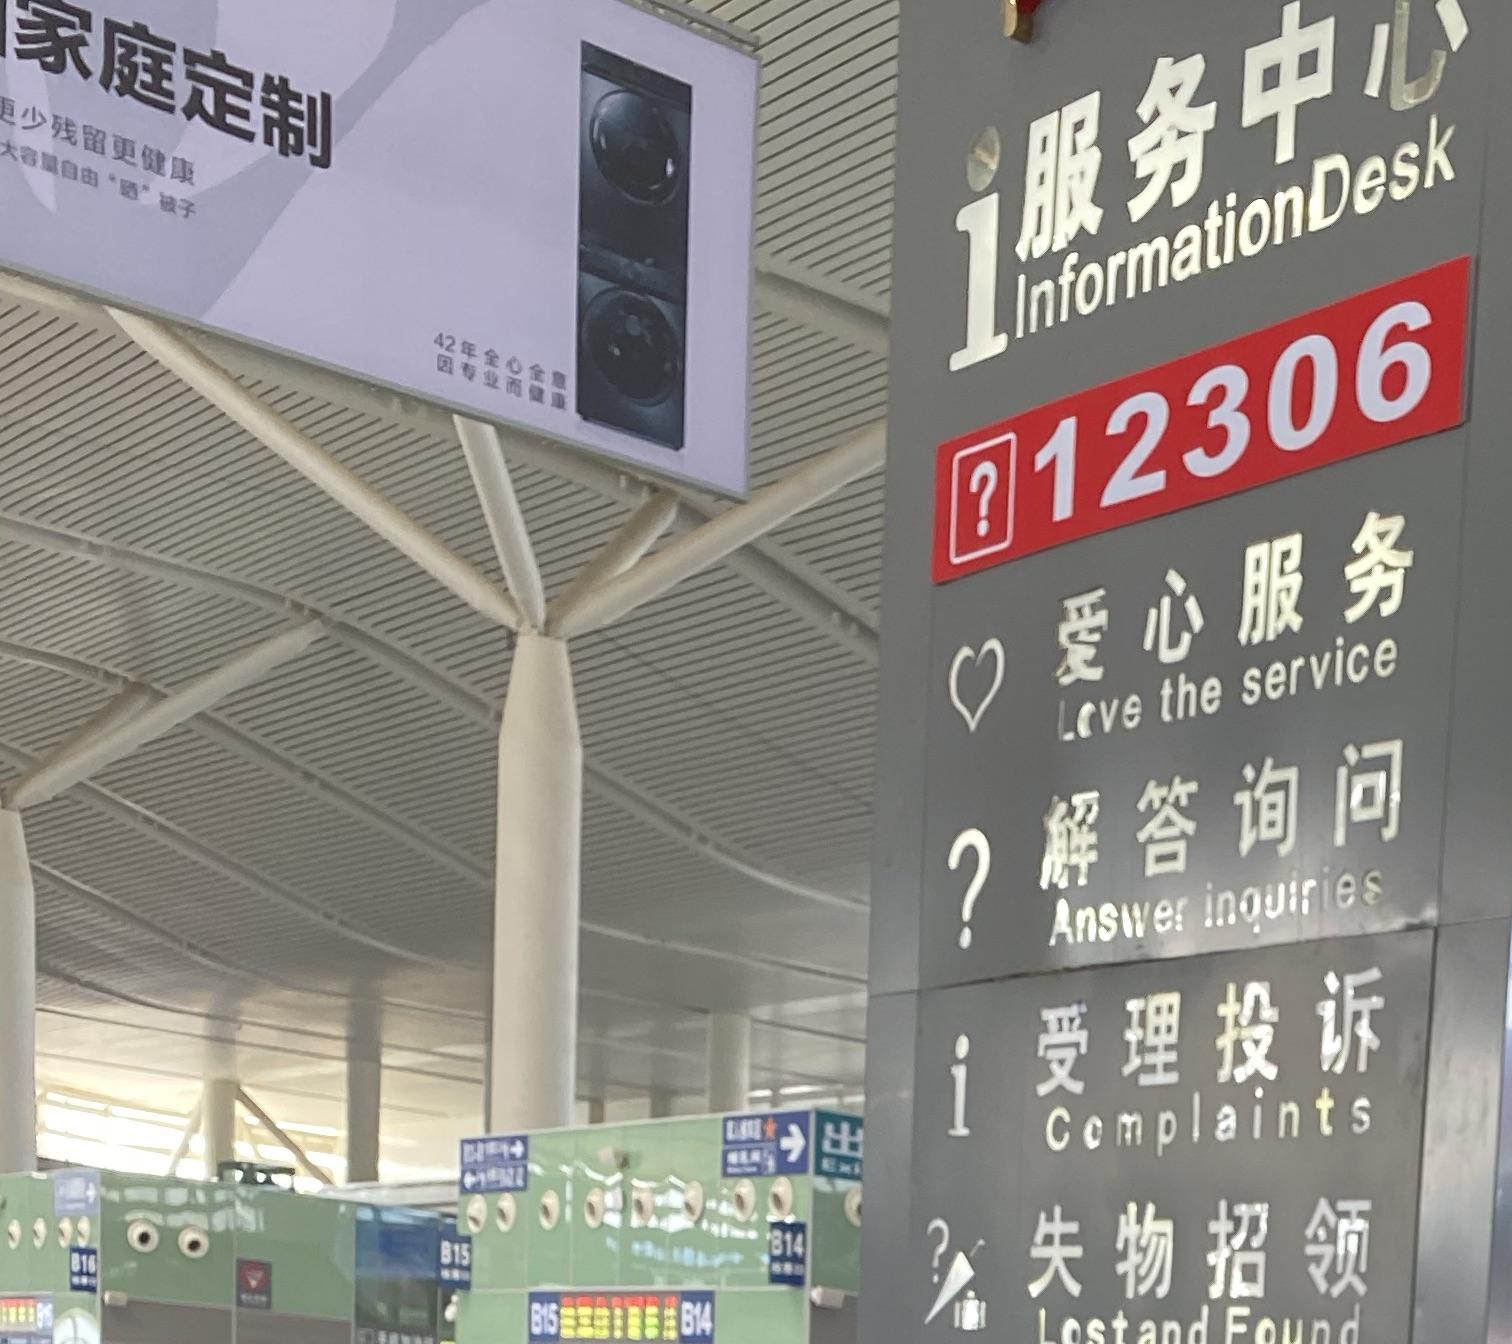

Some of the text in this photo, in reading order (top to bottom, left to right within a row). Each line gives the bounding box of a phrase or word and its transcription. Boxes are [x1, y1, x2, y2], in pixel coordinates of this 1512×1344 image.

[0, 0, 332, 169] 家庭定制
[1014, 0, 1470, 263] 服务中心
[1033, 300, 1433, 522] 12306
[1056, 511, 1414, 686] 爱心服务
[1160, 673, 1223, 723] the
[1241, 636, 1399, 707] service
[1039, 738, 1403, 890] 解答询问
[1048, 868, 1384, 946] Answer inquiries
[1036, 967, 1385, 1097] 受理投诉
[1045, 1087, 1372, 1157] Complaints
[440, 1240, 471, 1266] B15
[771, 1228, 804, 1258] B14
[1027, 1197, 1373, 1300] 失物招领
[530, 1301, 559, 1336] B15
[680, 1301, 713, 1337] B14
